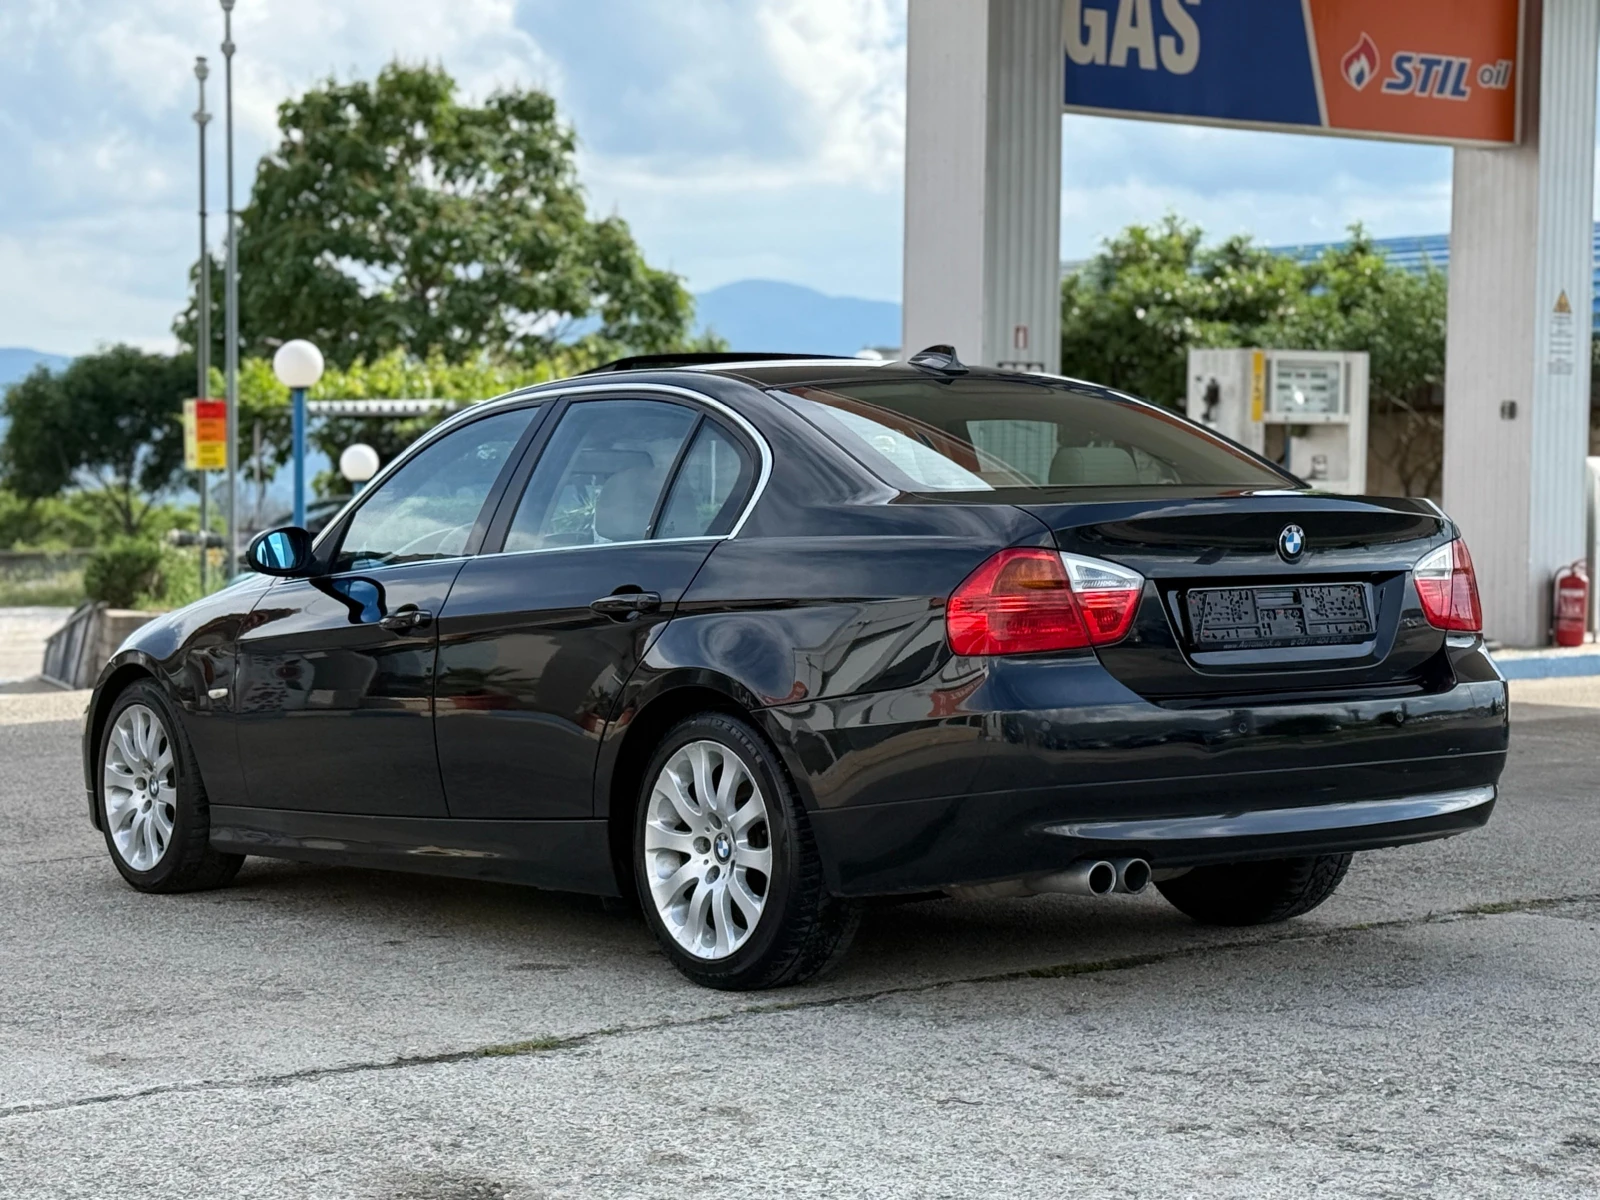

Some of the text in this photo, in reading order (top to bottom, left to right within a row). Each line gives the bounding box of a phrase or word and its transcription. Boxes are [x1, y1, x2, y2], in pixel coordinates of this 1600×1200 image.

[1063, 0, 1201, 75] GAS
[1382, 52, 1511, 100] STIL oil
